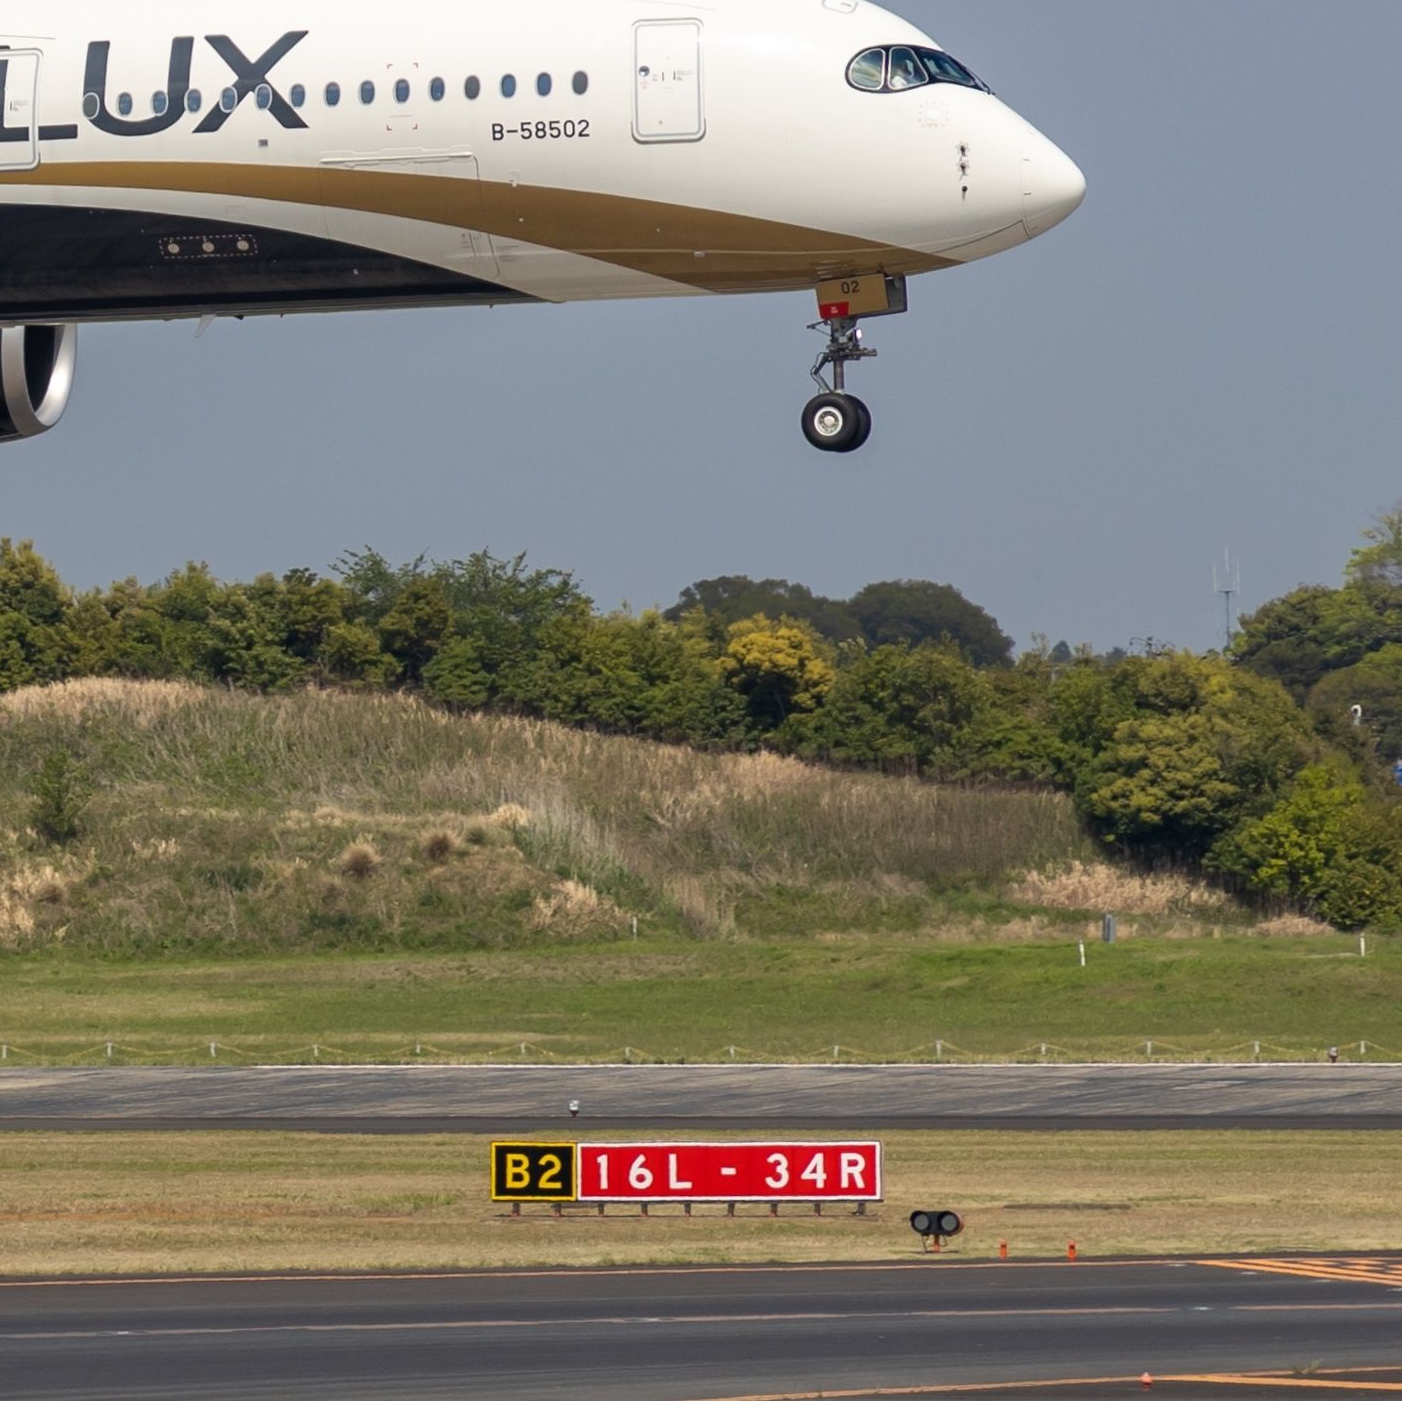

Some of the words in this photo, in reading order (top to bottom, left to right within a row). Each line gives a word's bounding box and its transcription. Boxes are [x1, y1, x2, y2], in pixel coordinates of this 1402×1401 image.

[492, 119, 590, 141] B-58502
[841, 280, 860, 295] 02
[505, 1153, 563, 1190] B2
[596, 1153, 693, 1191] 16L
[764, 1153, 866, 1189] 34R
